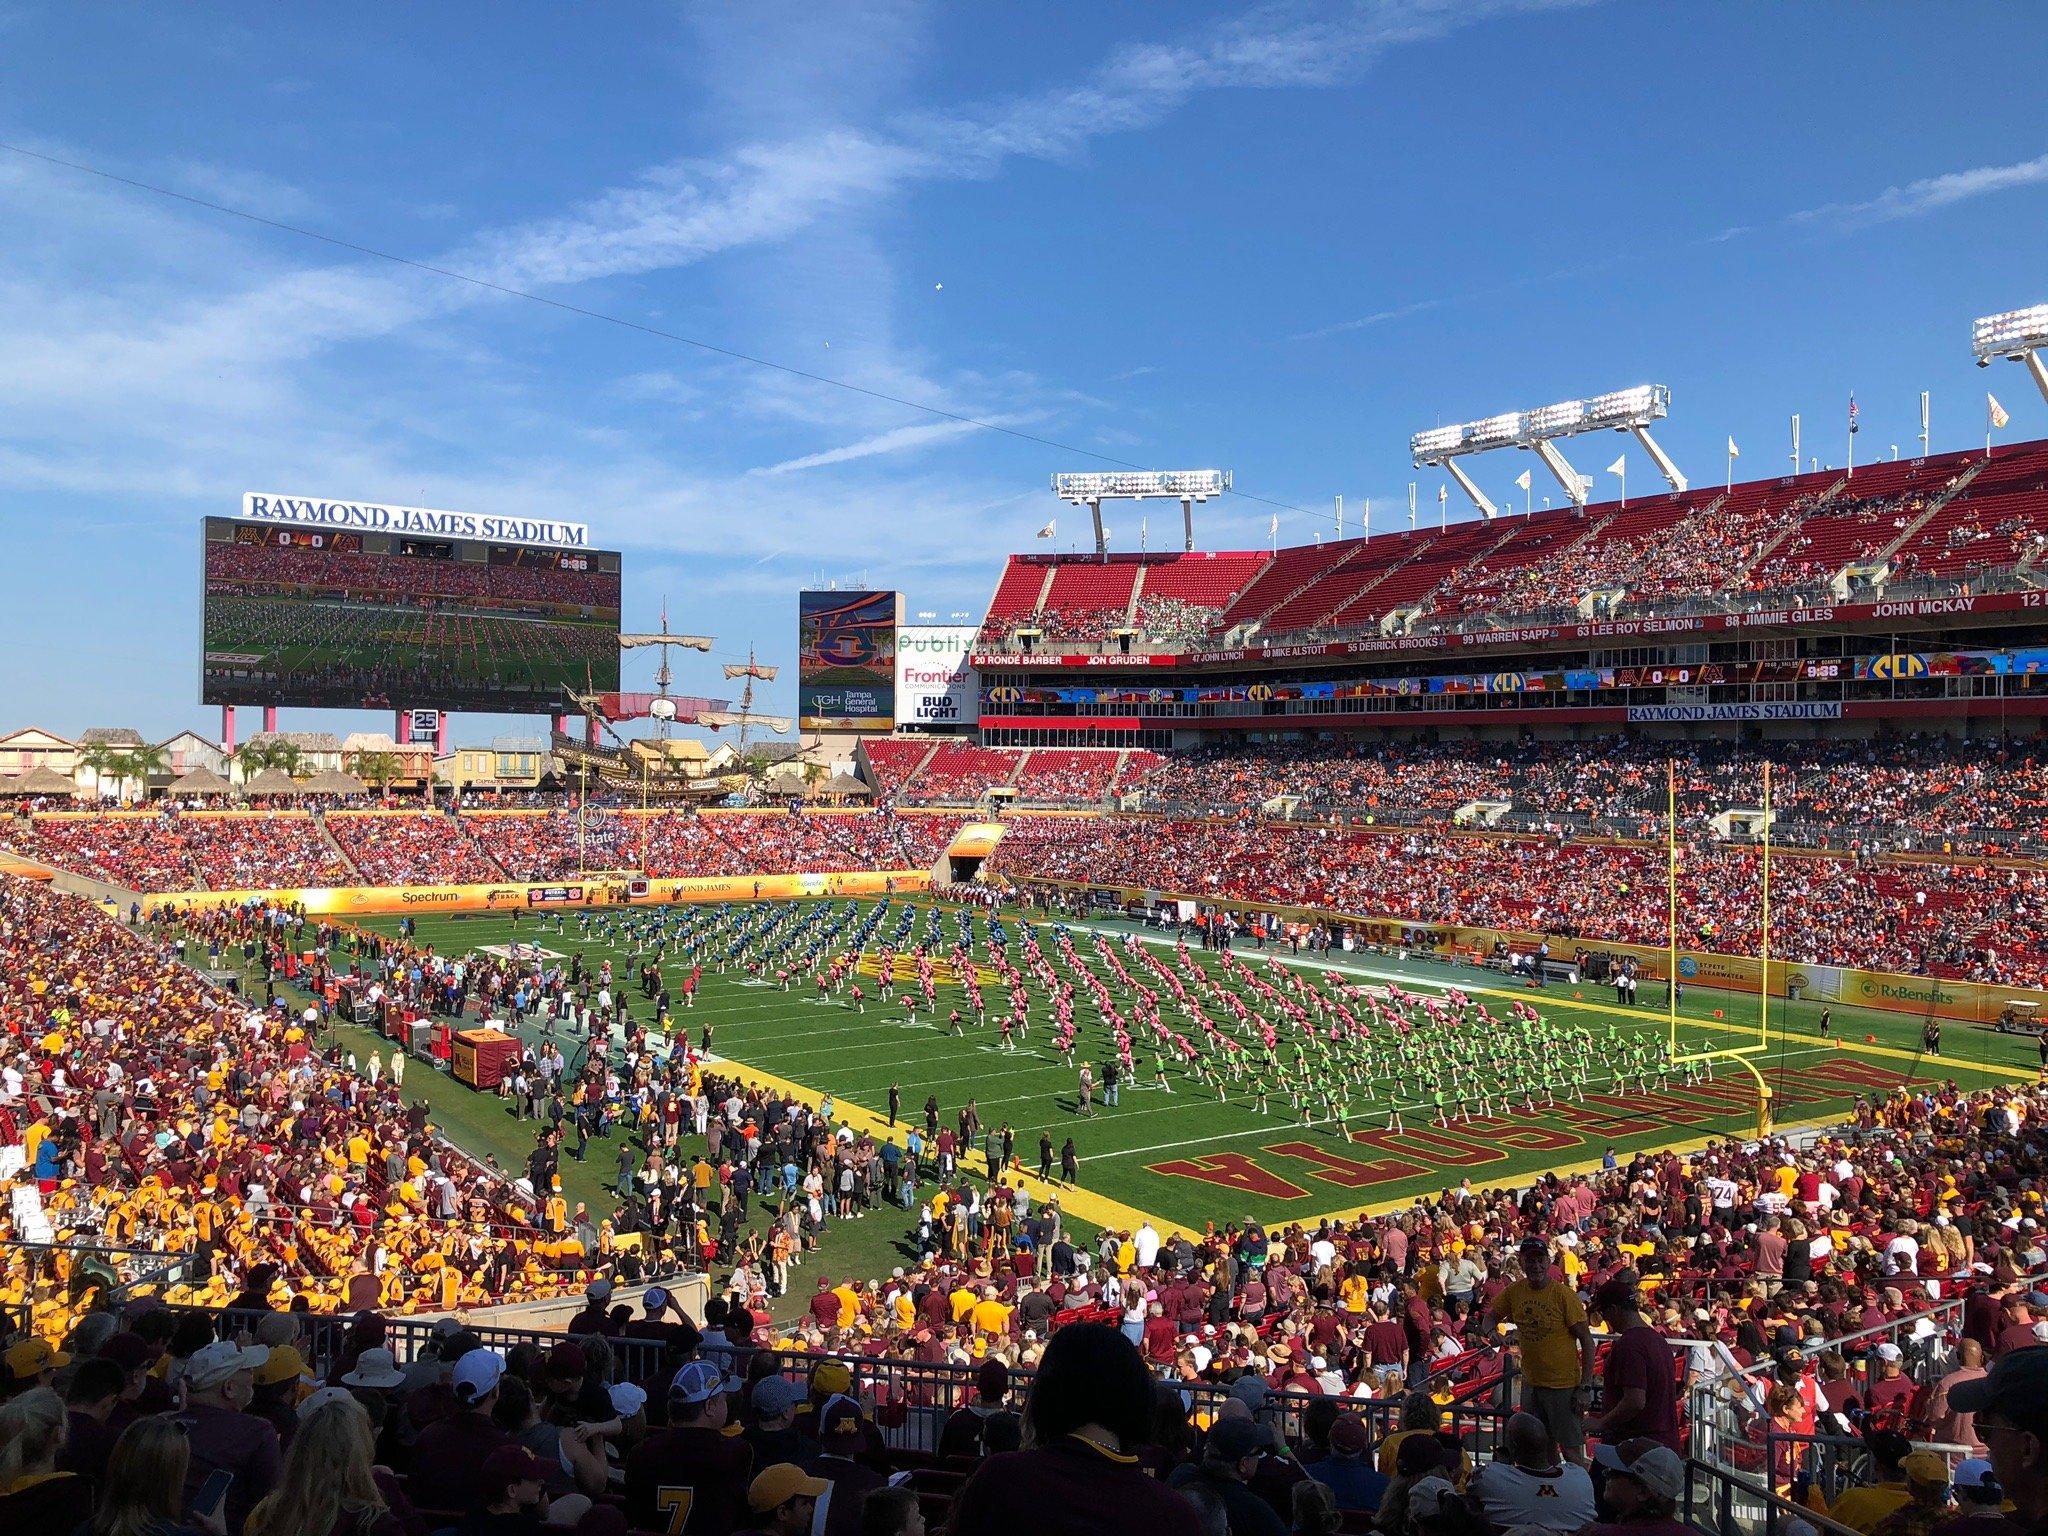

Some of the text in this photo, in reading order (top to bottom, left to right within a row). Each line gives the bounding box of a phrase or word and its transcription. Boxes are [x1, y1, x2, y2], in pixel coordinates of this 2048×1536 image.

[1910, 459, 1925, 467] 335
[250, 496, 584, 545] RAYMOND JAMES STADIUM
[279, 532, 291, 545] 0
[312, 535, 323, 547] 0
[2021, 594, 2040, 606] 12
[1872, 598, 1975, 617] JOHN MCKAY
[1725, 608, 1833, 627] 88 JIMMIE GILES
[1577, 619, 1693, 637] 63 LEE ROY SELMON
[1462, 629, 1549, 644] 99 WARREN SAPP
[1348, 637, 1438, 652] 55 DERRICK BROOKS
[1201, 653, 1219, 661] JOHN
[1221, 652, 1244, 660] LYNCH
[1262, 645, 1327, 658] 40 MIKE ALSTOTT
[975, 654, 1062, 665] 20 RONDÉ BARBER
[1087, 656, 1150, 665] JON GRUDEN
[905, 668, 969, 684] Frontier
[1652, 670, 1663, 683] 0
[1679, 670, 1689, 683] 0
[1807, 665, 1838, 678] 9:38
[815, 695, 841, 705] TGH
[845, 691, 872, 699] Tampa
[923, 696, 952, 706] BUD
[845, 705, 878, 714] Hospital
[917, 708, 958, 718] LIGHT
[1629, 703, 1839, 720] RAYMOND JAMES STADIUM
[415, 713, 436, 727] 25
[571, 831, 616, 844] Alstate
[704, 883, 731, 892] JAMES
[402, 892, 458, 904] Spectrum
[1699, 970, 1744, 980] CLEARWATER
[1881, 984, 1954, 1004] RxBenefits
[1714, 1186, 1732, 1200] 74
[657, 1485, 694, 1536] 7
